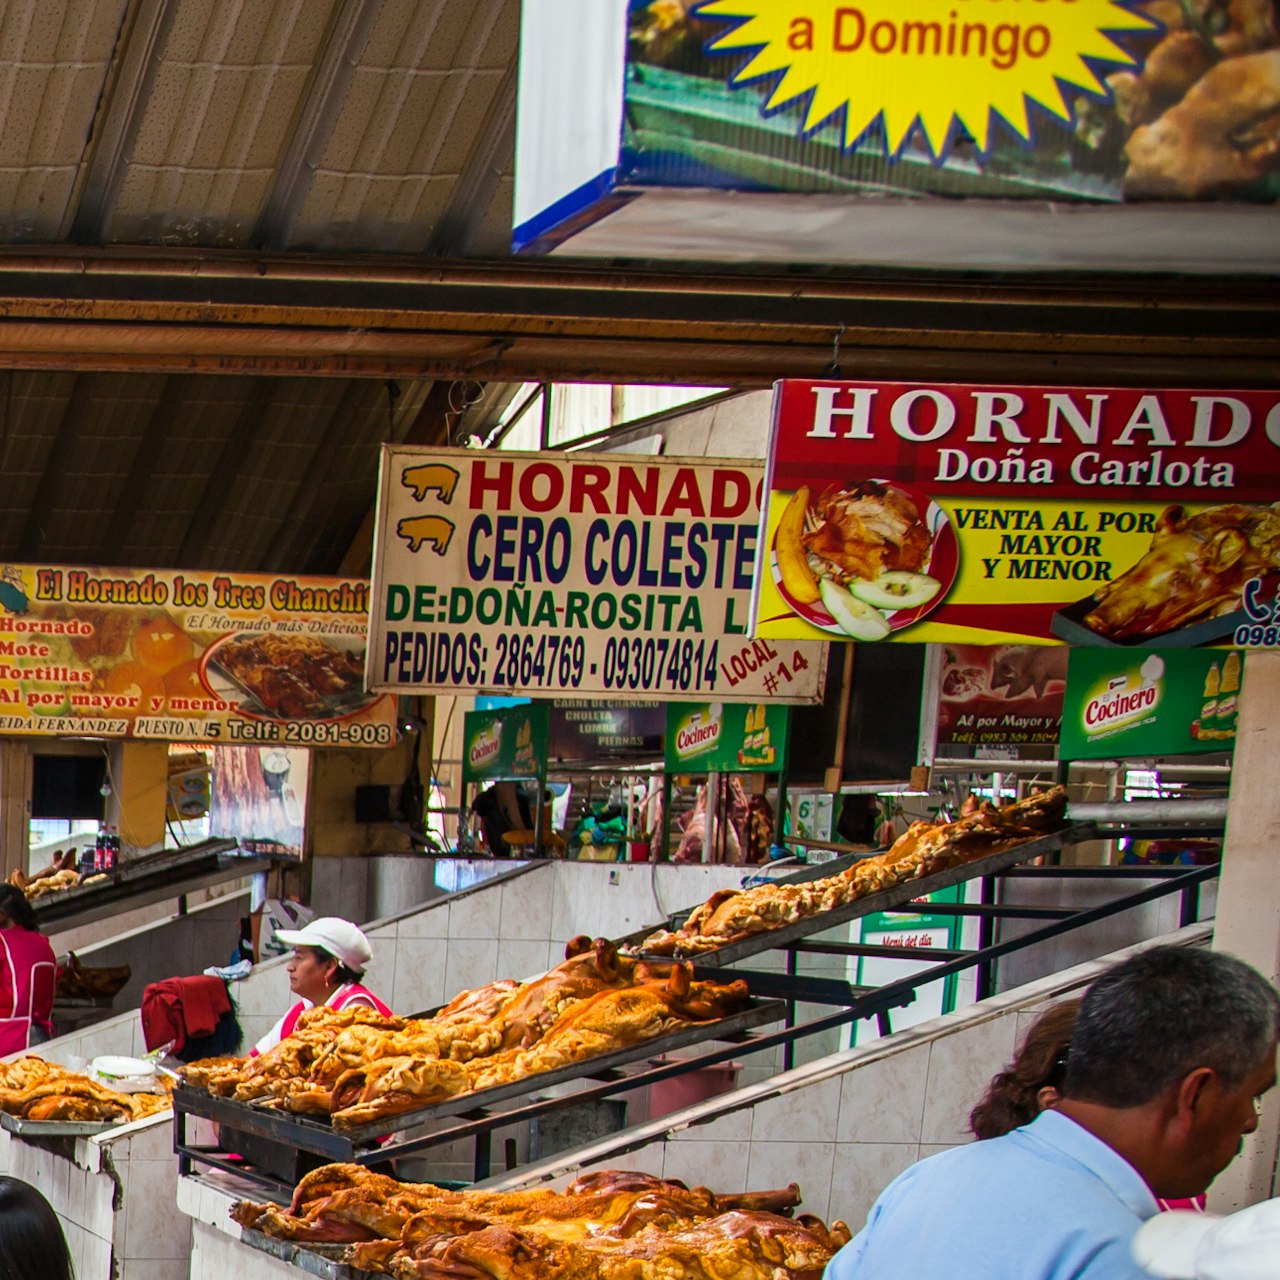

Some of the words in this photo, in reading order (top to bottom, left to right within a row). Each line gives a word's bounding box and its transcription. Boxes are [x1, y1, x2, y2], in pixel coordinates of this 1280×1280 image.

[787, 16, 814, 51] a
[832, 7, 1052, 70] Domingo
[806, 386, 1280, 447] HORNAD
[934, 447, 1054, 484] Doña
[1070, 450, 1236, 488] Carlota
[468, 460, 765, 518] HORNAD
[953, 507, 1044, 532] VENTA
[1051, 510, 1088, 532] AL
[1096, 511, 1157, 533] POR
[467, 513, 572, 585] CERO
[584, 517, 758, 590] COLESTE
[998, 534, 1102, 557] MAYOR
[983, 558, 1000, 579] Y
[1007, 559, 1113, 581] MENOR
[37, 568, 63, 601] El
[68, 570, 169, 606] Hornado
[173, 576, 208, 607] los
[213, 577, 265, 609] Tres
[187, 616, 205, 629] El
[208, 616, 271, 630] Hornado
[276, 621, 302, 633] más
[724, 597, 749, 634] L
[1234, 624, 1280, 648] 098
[383, 630, 487, 685] PEDIDOS:
[493, 631, 584, 687] 2864769
[603, 636, 719, 691] 093074814
[721, 639, 778, 687] LOCAL
[762, 650, 809, 696] #14
[27, 691, 64, 708] por
[72, 692, 139, 710] mayor
[151, 696, 165, 711] y
[171, 696, 240, 712] menor
[1086, 687, 1156, 725] Cocinero
[137, 718, 185, 736] PUESTO
[228, 720, 279, 740] Telf:
[286, 722, 391, 744] 2081-908
[677, 722, 719, 750] Cocinero
[977, 716, 997, 728] por
[1000, 714, 1042, 729] Mayor
